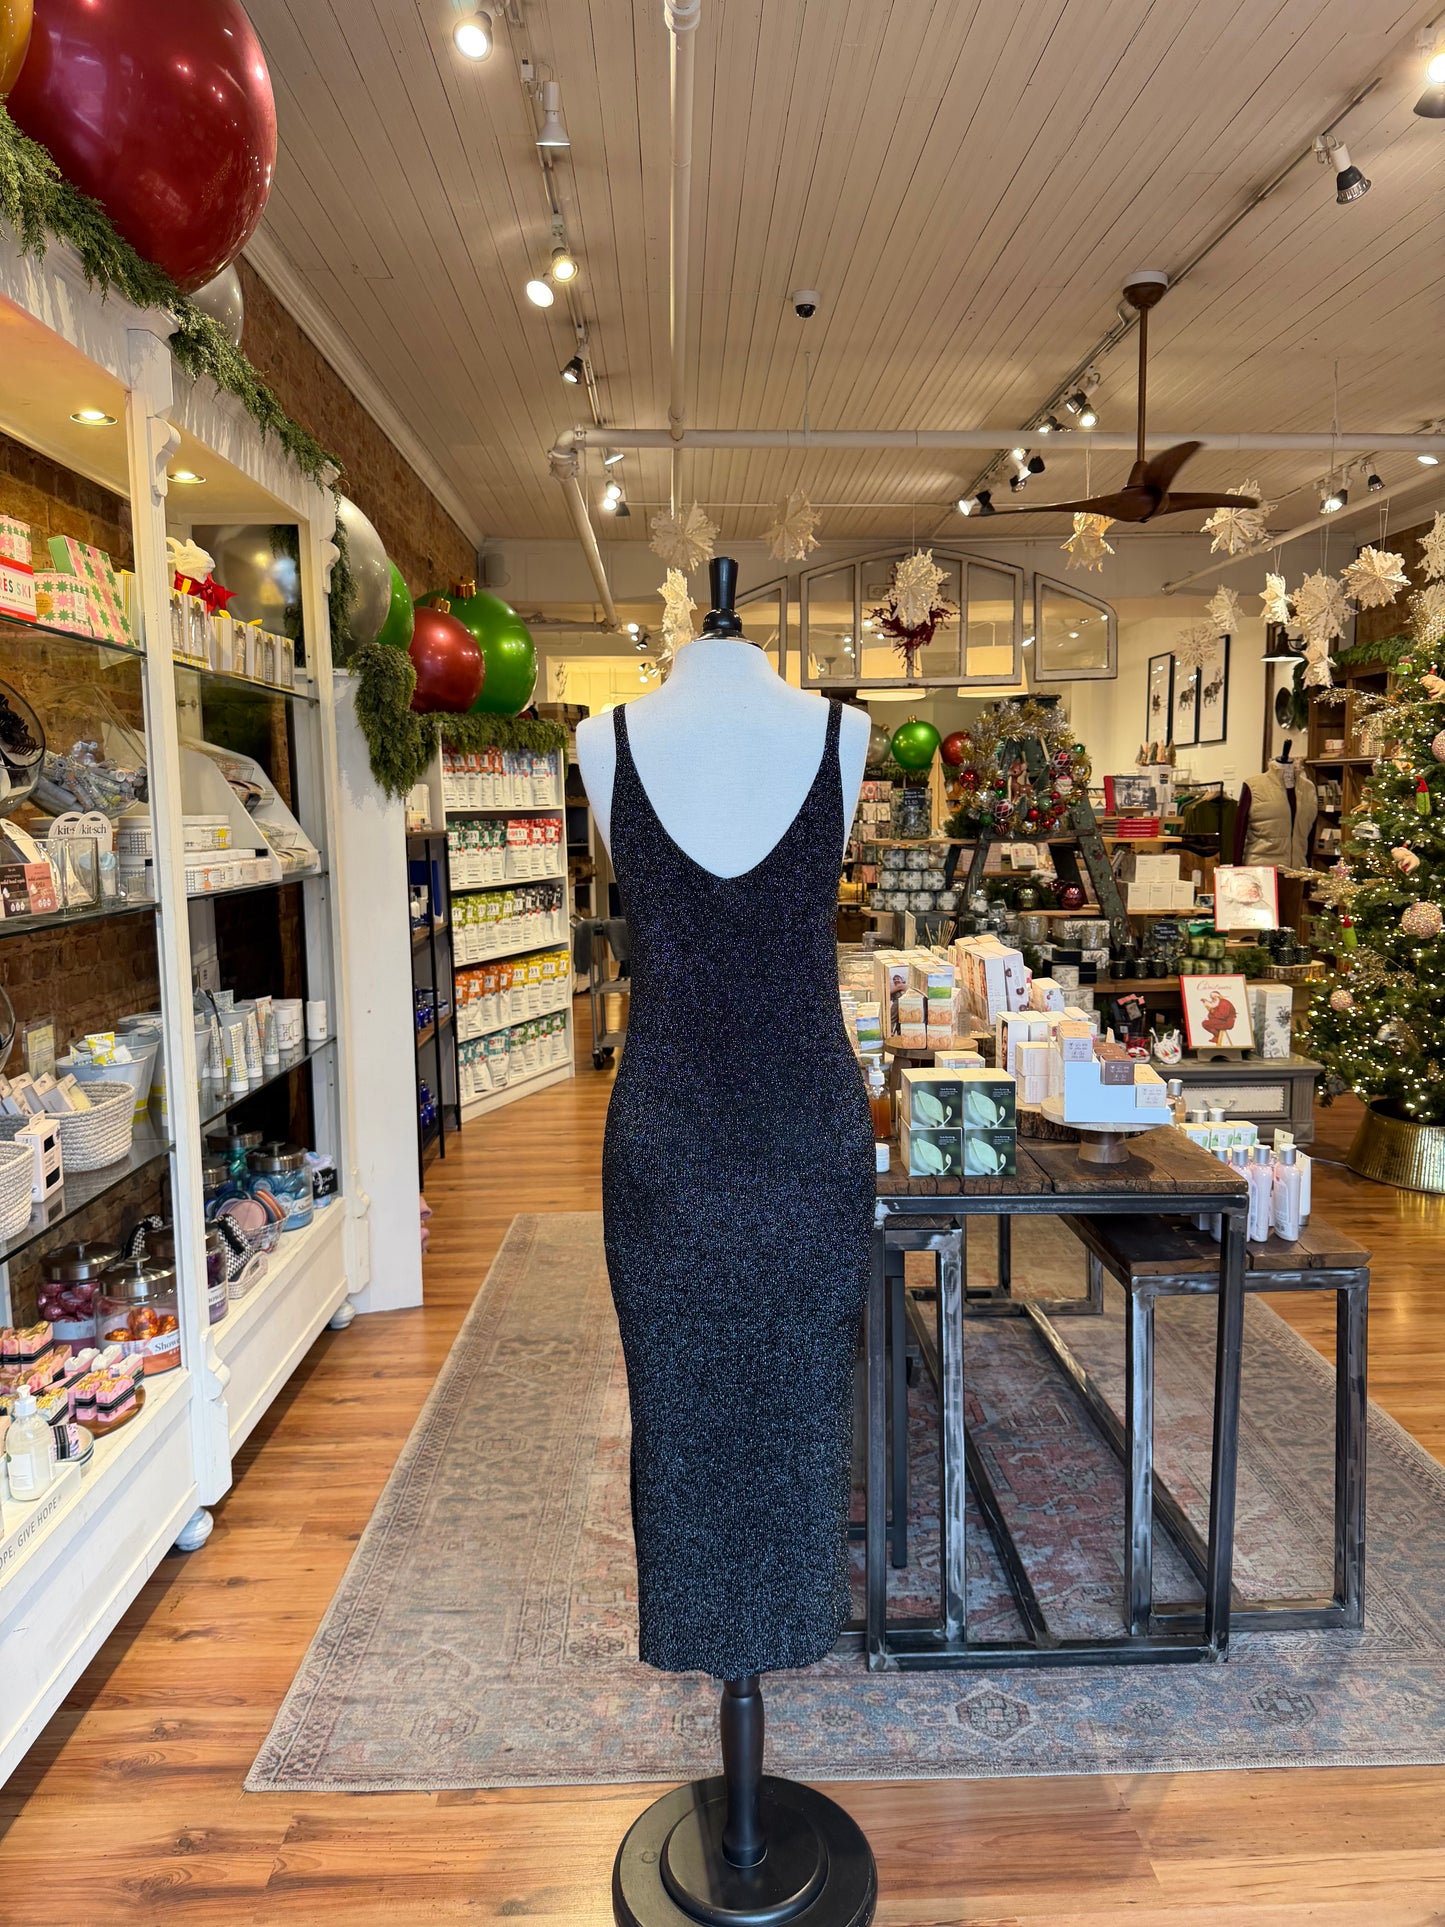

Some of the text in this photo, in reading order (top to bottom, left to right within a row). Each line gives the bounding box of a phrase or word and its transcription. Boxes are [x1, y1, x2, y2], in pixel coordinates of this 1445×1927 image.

[16, 582, 31, 599] SKI
[17, 1521, 36, 1548] GIVE
[37, 1496, 57, 1527] HOPE
